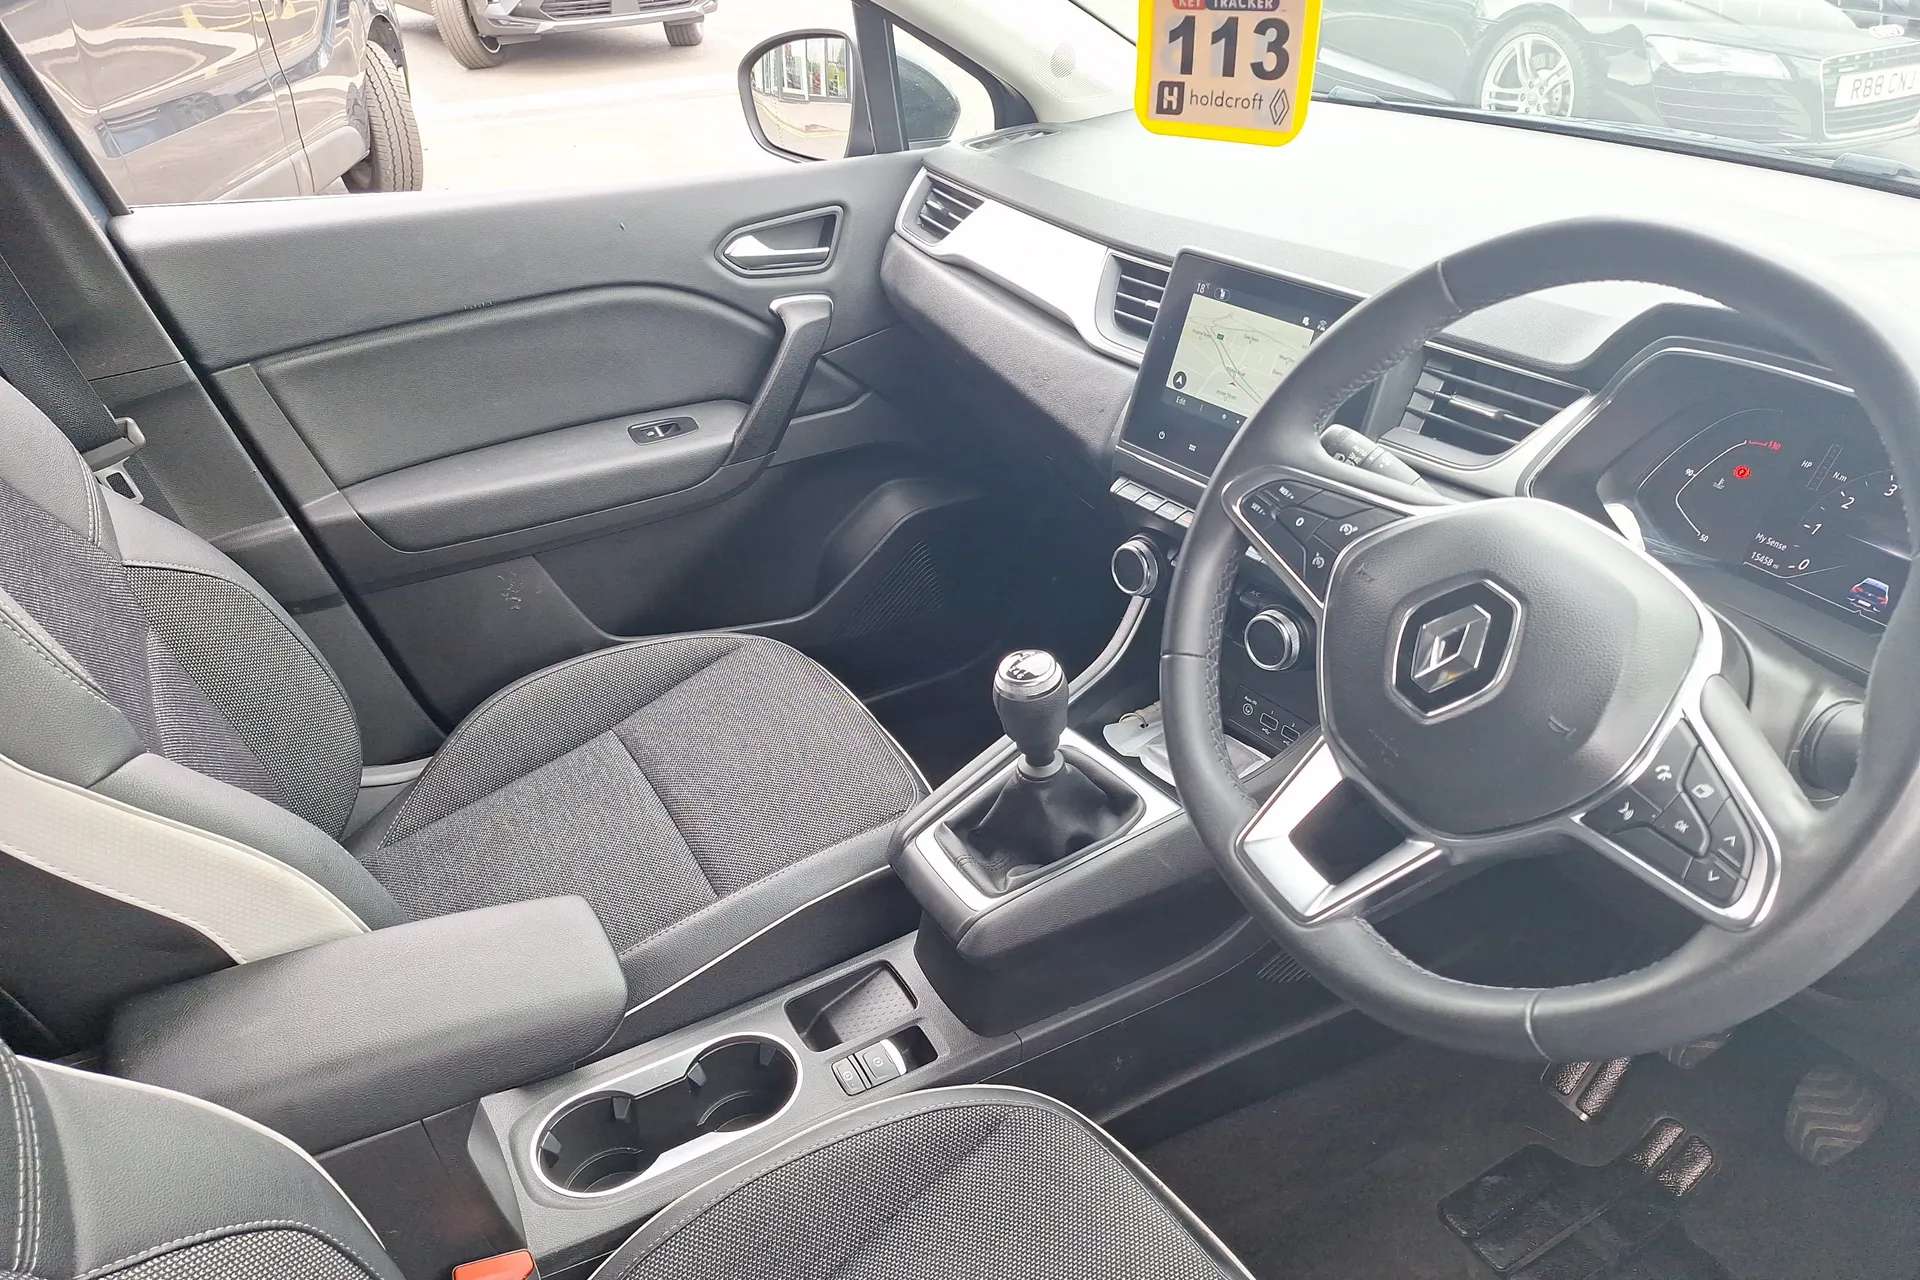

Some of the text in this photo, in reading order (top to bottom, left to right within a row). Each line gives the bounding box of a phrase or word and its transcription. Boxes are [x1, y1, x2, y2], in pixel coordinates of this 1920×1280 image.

[1213, 0, 1274, 9] TRACKER
[1168, 15, 1290, 81] 113
[1189, 89, 1264, 111] holdcroft
[1801, 460, 1813, 469] HP
[1884, 484, 1898, 496] 3
[1841, 496, 1855, 509] 2
[1811, 523, 1822, 535] 1
[1700, 533, 1709, 543] 50
[1755, 532, 1787, 551] My Sense
[1751, 551, 1774, 567] 15458
[1798, 558, 1810, 570] 0
